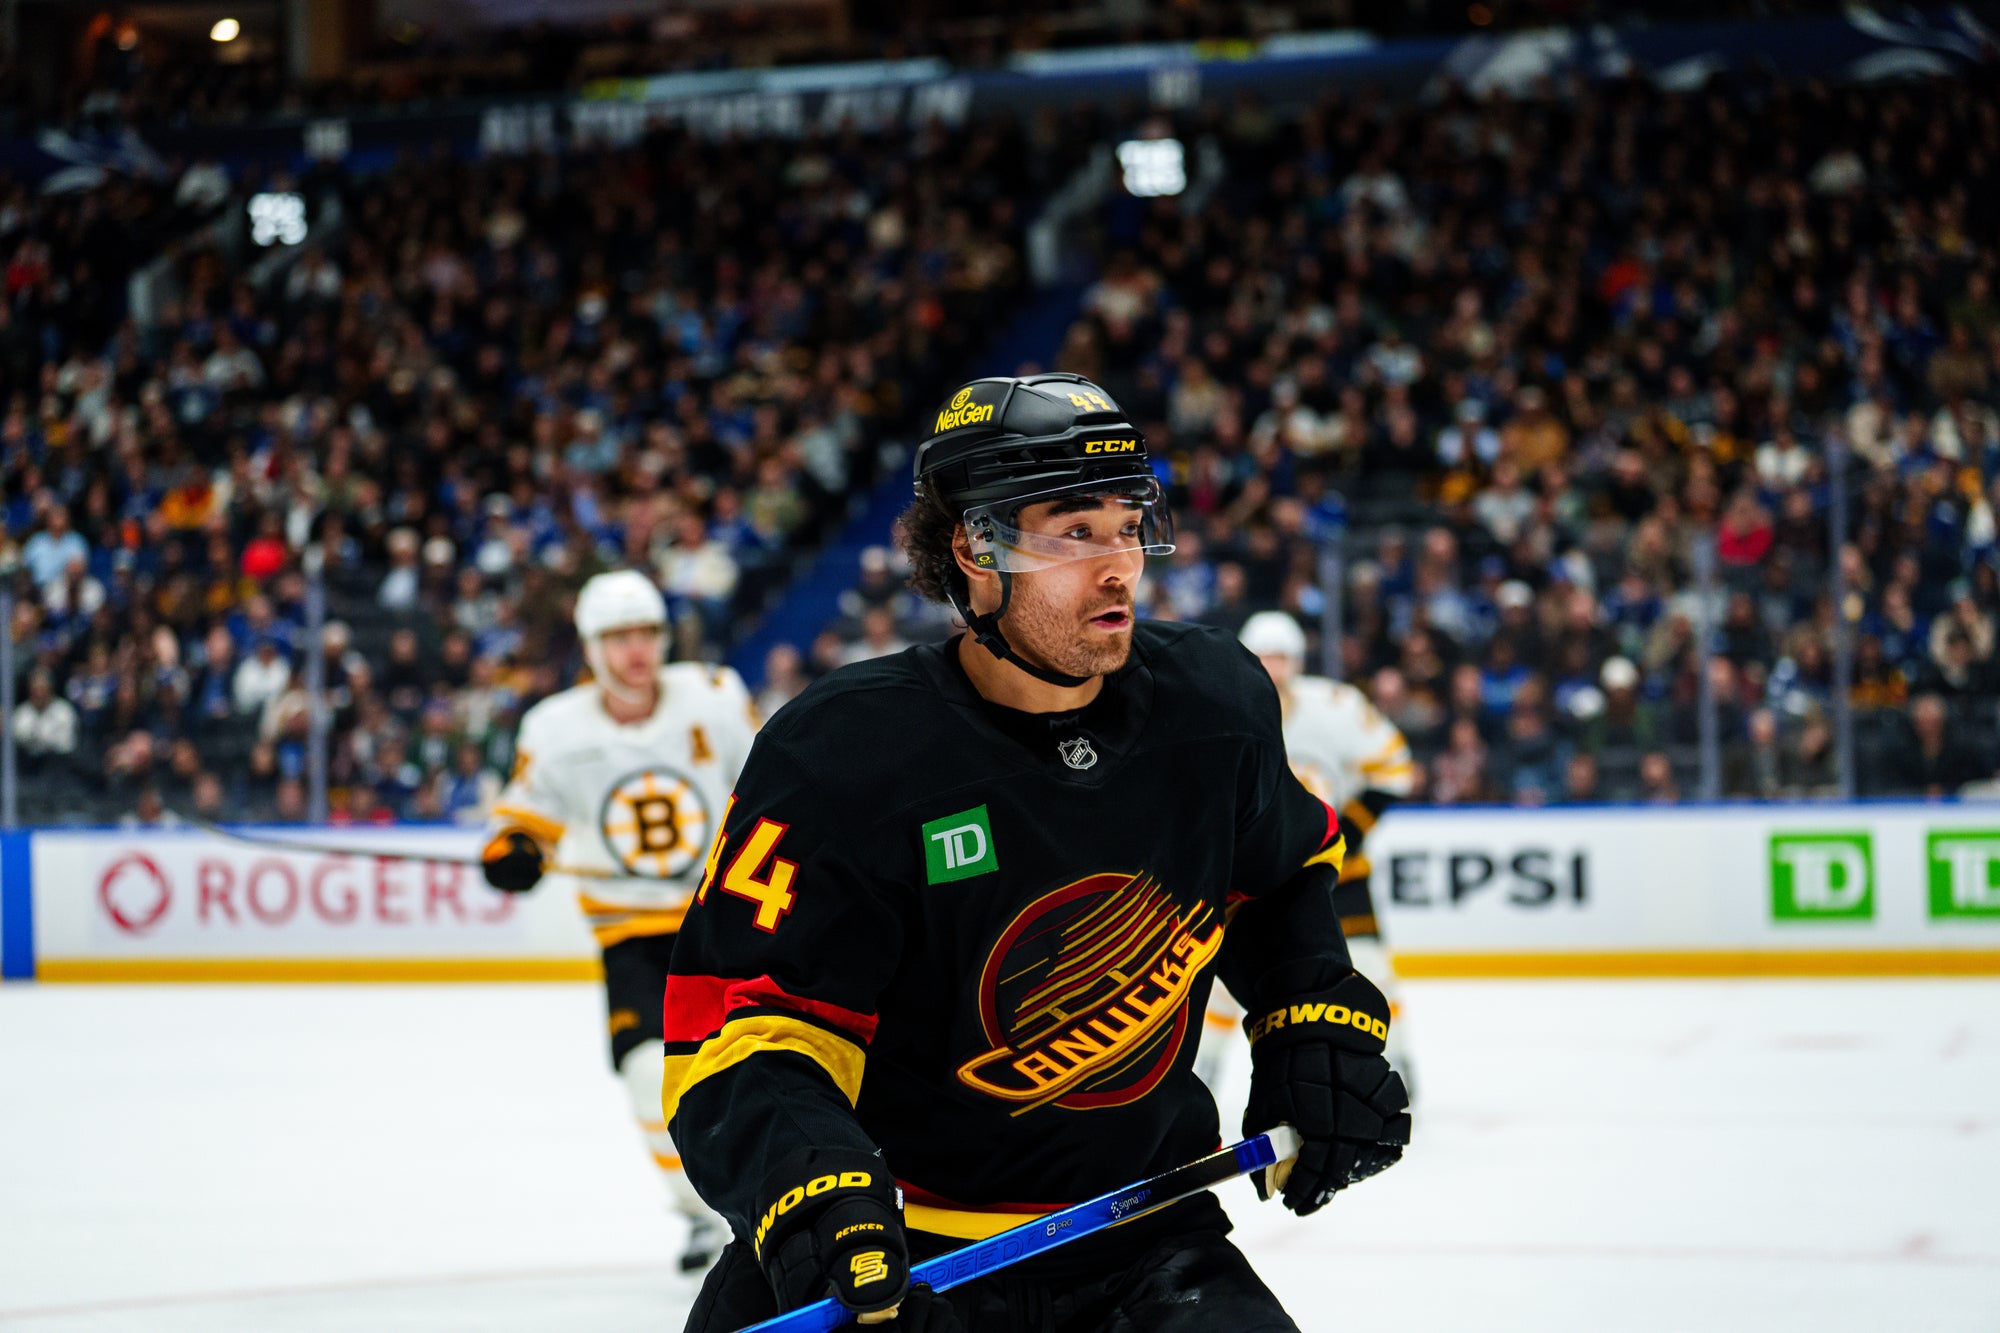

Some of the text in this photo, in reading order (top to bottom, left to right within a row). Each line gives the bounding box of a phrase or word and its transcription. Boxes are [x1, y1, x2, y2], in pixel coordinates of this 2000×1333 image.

[934, 402, 993, 434] NexGen
[1067, 391, 1112, 412] 44
[1084, 439, 1136, 454] CCM
[634, 796, 680, 853] B
[931, 823, 988, 870] TD
[1389, 850, 1587, 907] EPSI
[1775, 838, 1869, 910] TD
[1250, 1002, 1389, 1048] ERWOOD
[754, 1171, 872, 1263] WOOD
[835, 1223, 884, 1241] REKKER
